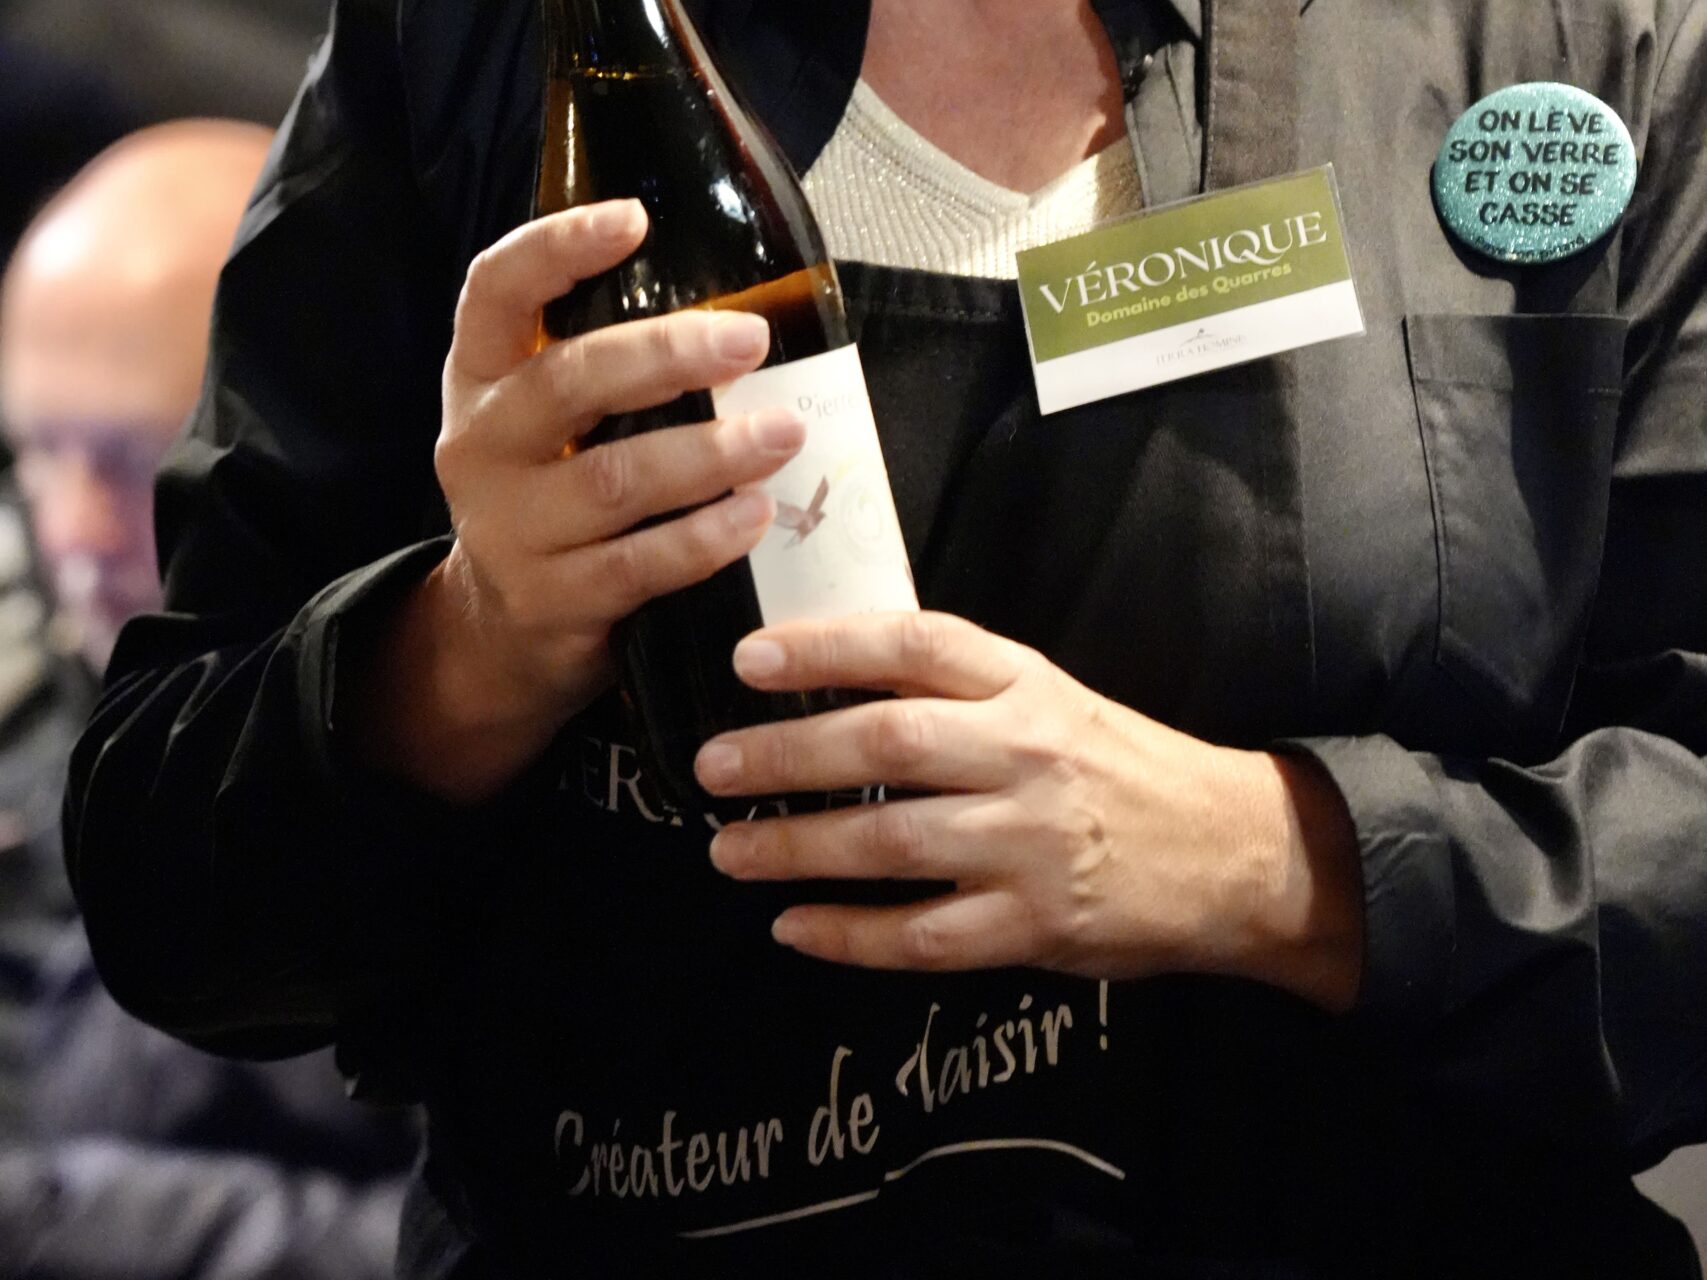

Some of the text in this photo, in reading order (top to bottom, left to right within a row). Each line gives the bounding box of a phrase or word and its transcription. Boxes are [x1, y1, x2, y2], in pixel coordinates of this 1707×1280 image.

[1478, 109, 1521, 132] ON
[1449, 140, 1621, 165] SON VERRE
[1465, 171, 1598, 195] ET ON SE
[1479, 202, 1578, 226] CASSE
[1039, 211, 1328, 314] VÉRONIQUE
[1086, 262, 1292, 327] Domaine des Quarres
[554, 1109, 784, 1199] Créateur
[808, 1045, 880, 1166] de
